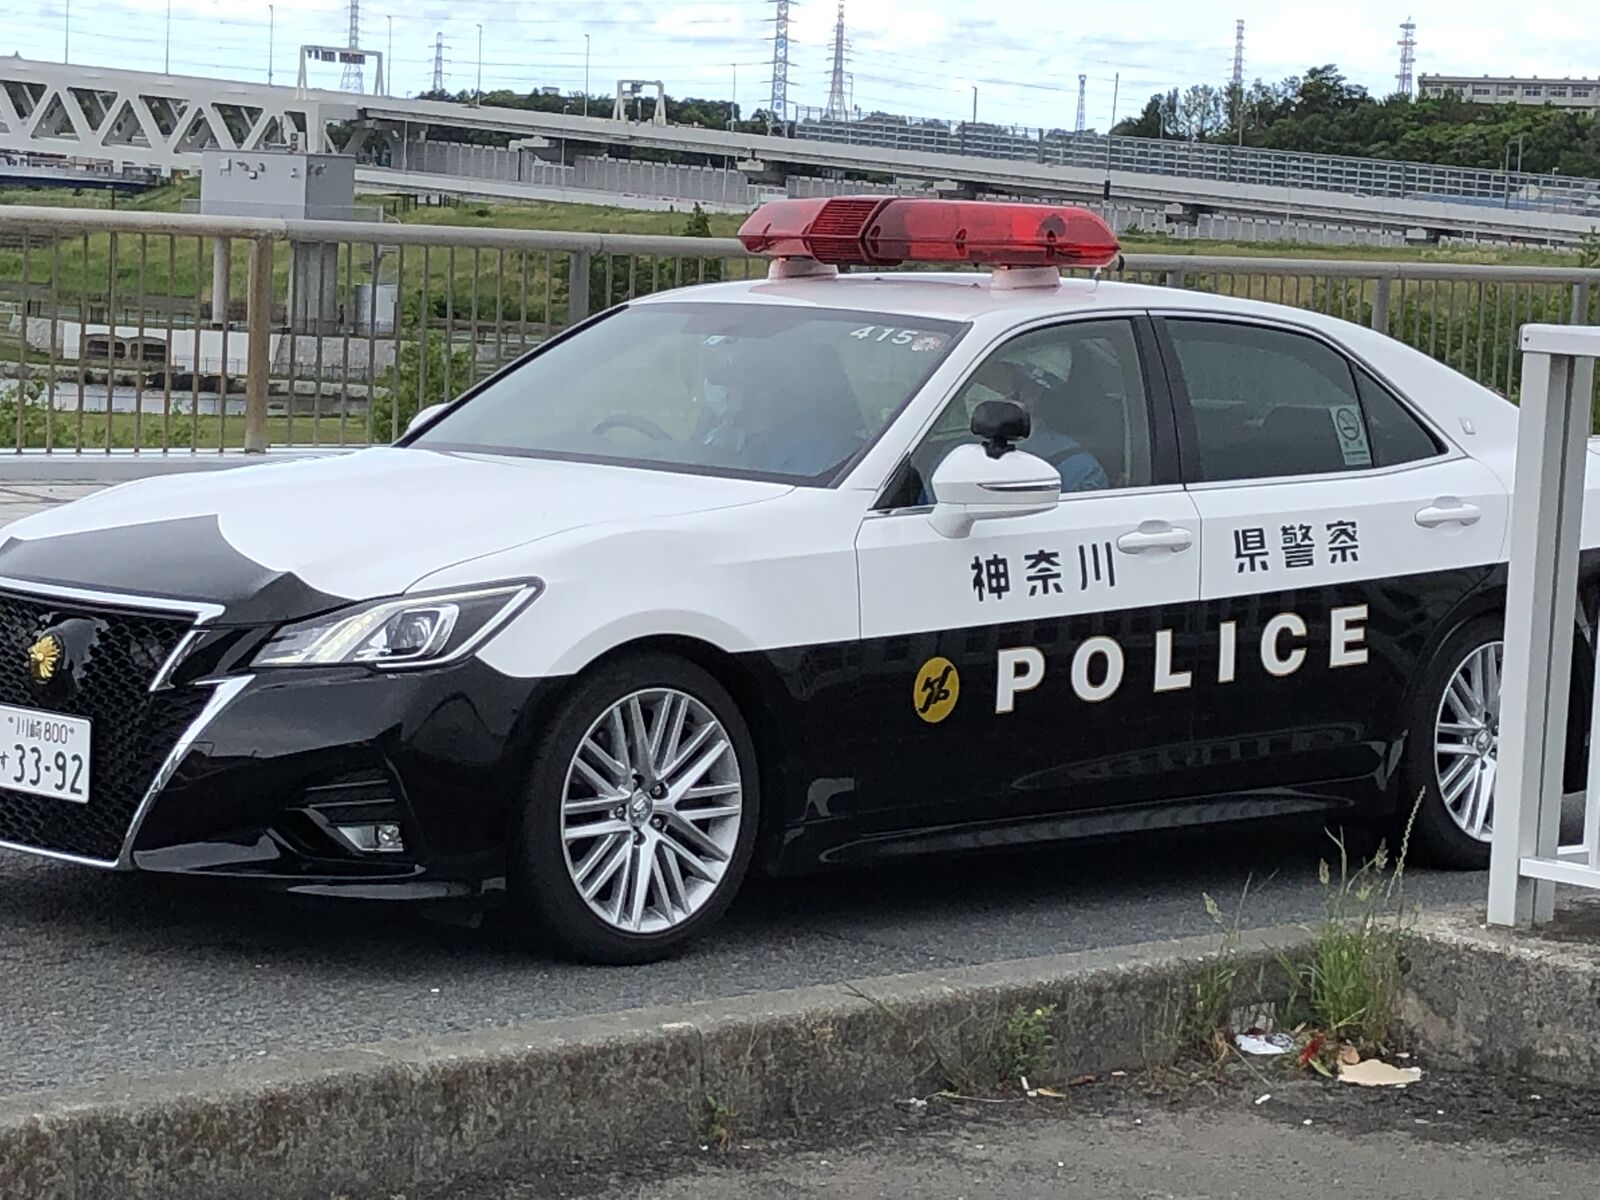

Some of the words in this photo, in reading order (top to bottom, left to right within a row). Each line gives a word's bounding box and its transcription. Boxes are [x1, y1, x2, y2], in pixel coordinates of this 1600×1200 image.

[850, 325, 919, 345] 415
[970, 541, 1116, 602] 神奈川
[1233, 520, 1360, 573] 県警察
[995, 604, 1369, 714] POLICE
[13, 744, 83, 795] 33-92
